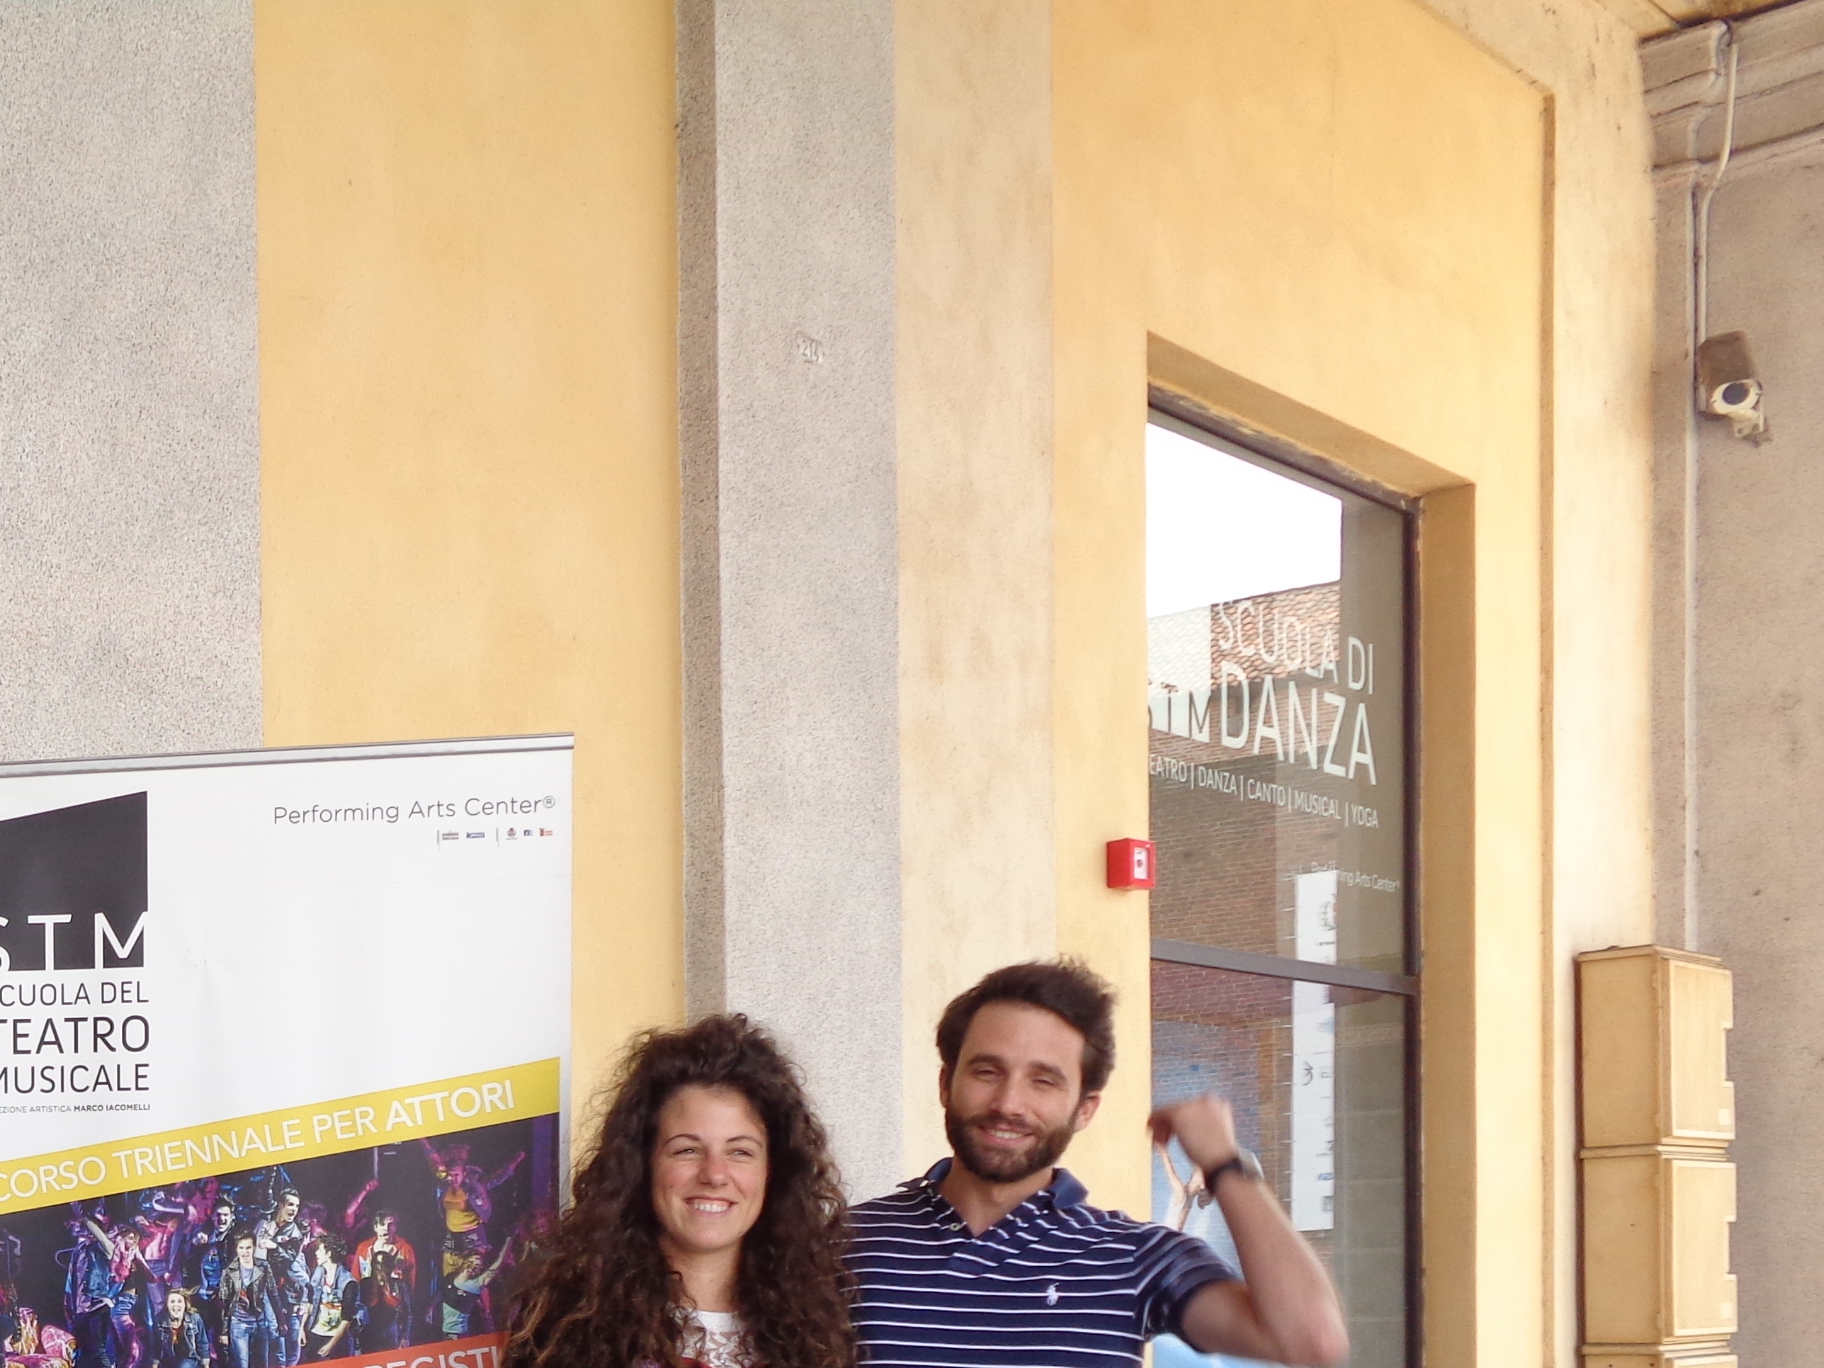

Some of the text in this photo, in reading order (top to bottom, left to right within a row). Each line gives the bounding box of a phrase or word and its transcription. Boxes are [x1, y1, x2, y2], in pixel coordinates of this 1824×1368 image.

[1218, 599, 1374, 695] SCUOLA DI
[1148, 660, 1377, 786] TM DANZA
[274, 801, 400, 824] Performing
[408, 799, 456, 819] Arts
[1149, 753, 1380, 829] EATRO DANZA CANTO MUSICAL YOGA
[101, 981, 149, 1004] DEL
[29, 1105, 72, 1113] ARTISTICA
[73, 1104, 104, 1112] MARCO
[105, 1103, 151, 1112] IACOMELLI
[112, 1118, 303, 1181] TRIENNALE
[311, 1104, 379, 1147] PER
[385, 1079, 518, 1132] ATTORI
